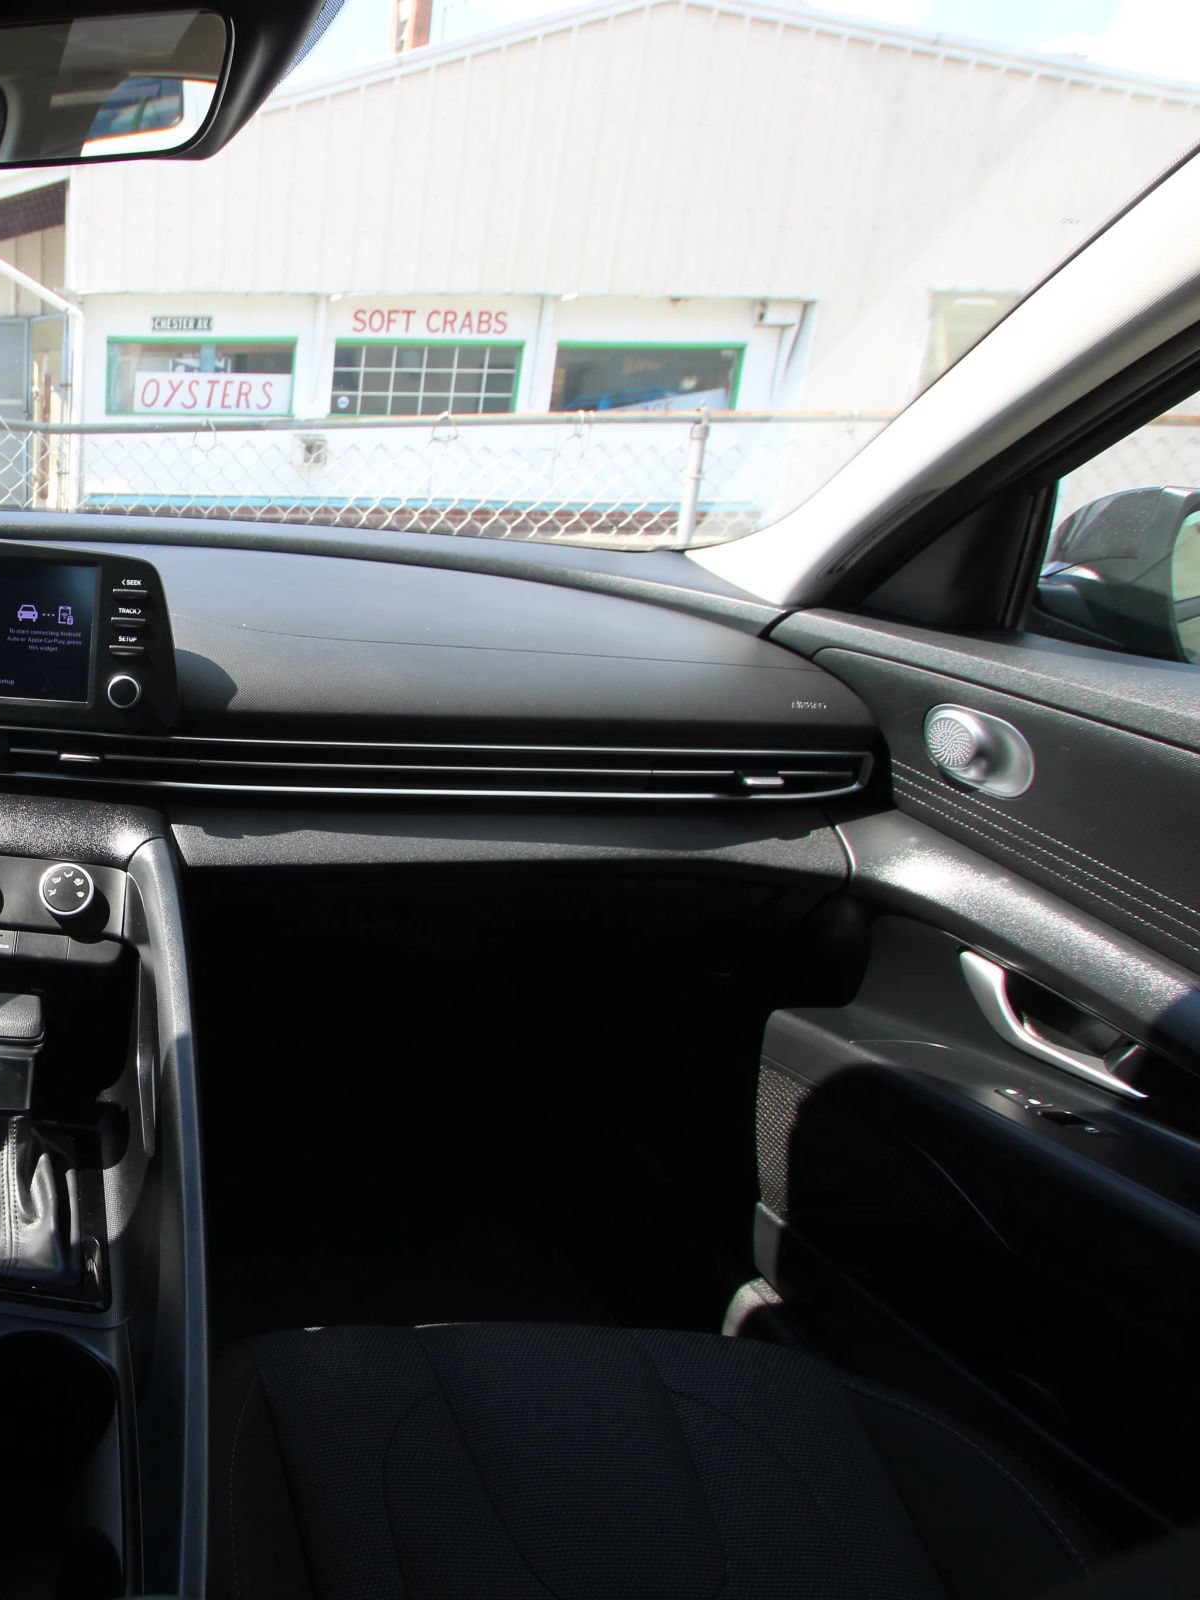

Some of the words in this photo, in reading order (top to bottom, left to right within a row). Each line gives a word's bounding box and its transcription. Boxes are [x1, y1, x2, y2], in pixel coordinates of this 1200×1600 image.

[155, 318, 194, 328] CHESTER
[353, 309, 416, 333] SOFT
[425, 310, 509, 335] CRABS
[141, 379, 273, 410] OYSTERS
